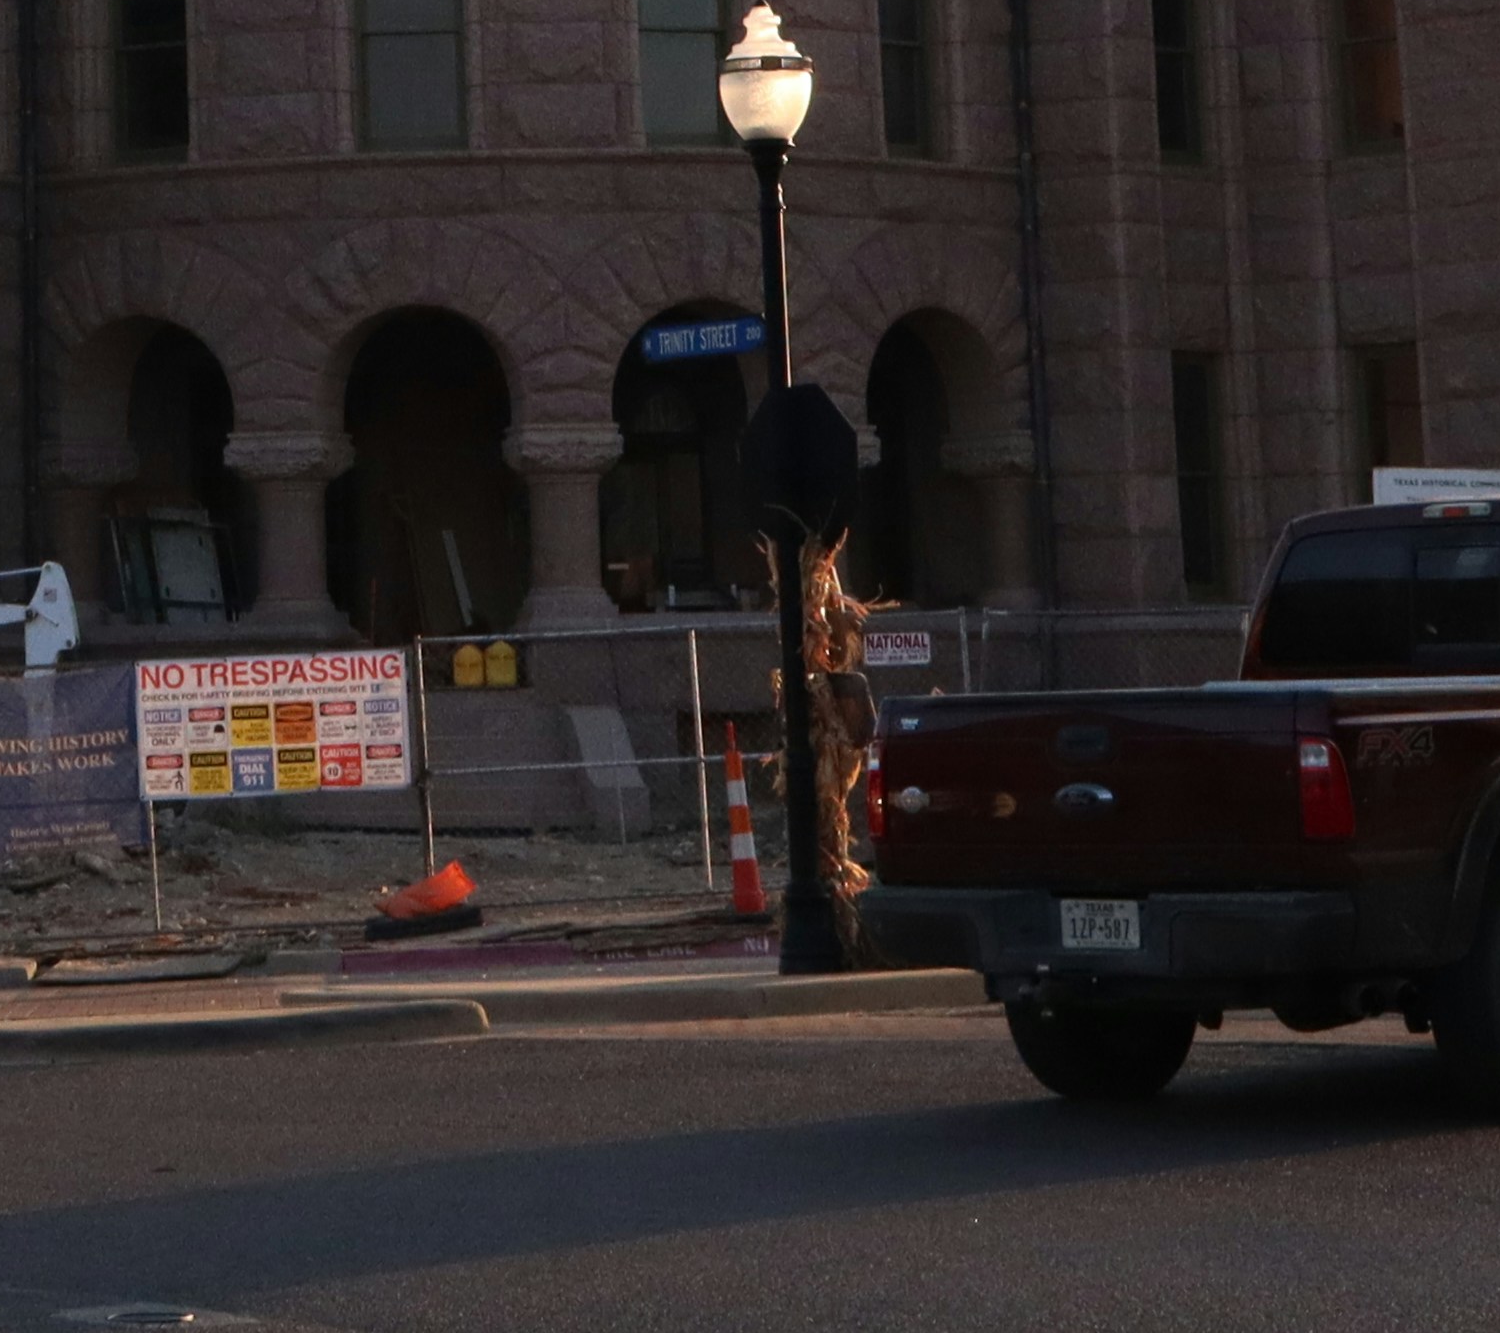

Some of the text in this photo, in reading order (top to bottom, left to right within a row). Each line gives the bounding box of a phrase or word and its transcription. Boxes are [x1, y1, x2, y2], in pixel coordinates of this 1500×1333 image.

[658, 329, 695, 354] TRINITY
[700, 324, 737, 350] STREET
[866, 634, 929, 649] NATIONAL
[140, 654, 401, 690] NO TRESPASSING
[141, 694, 171, 703] CHECK
[182, 693, 198, 701] FOR
[49, 729, 129, 751] HISTORY
[57, 751, 115, 771] WORK
[239, 763, 266, 773] DIAL
[243, 775, 264, 786] 911
